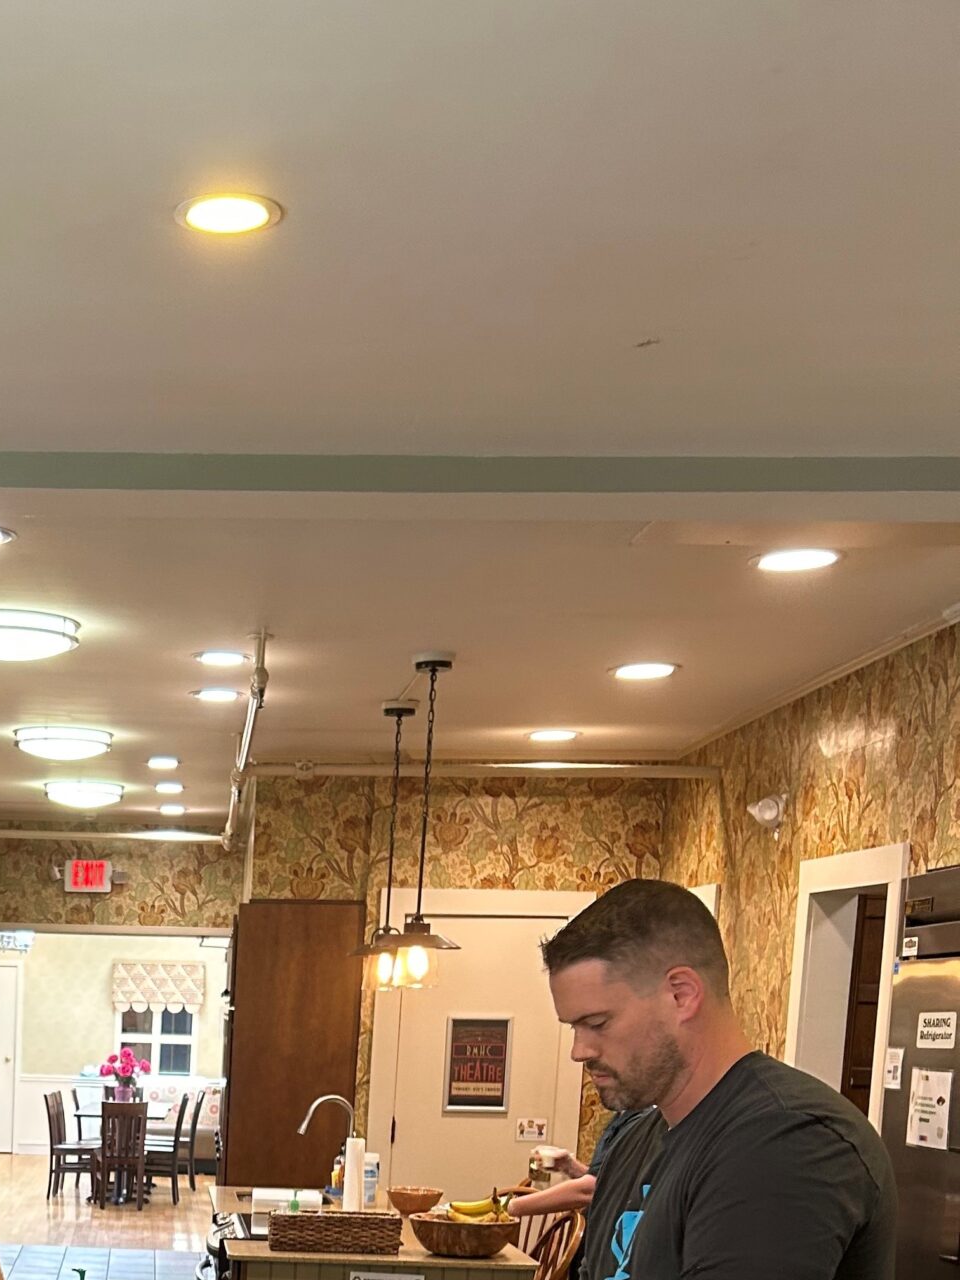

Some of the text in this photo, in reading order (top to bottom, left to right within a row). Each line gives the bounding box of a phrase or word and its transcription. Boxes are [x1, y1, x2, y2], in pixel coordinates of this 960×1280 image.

[72, 860, 106, 888] EXIT
[922, 1017, 951, 1028] SHARING
[919, 1030, 953, 1042] Refrigerator
[453, 1059, 503, 1081] THEATRE
